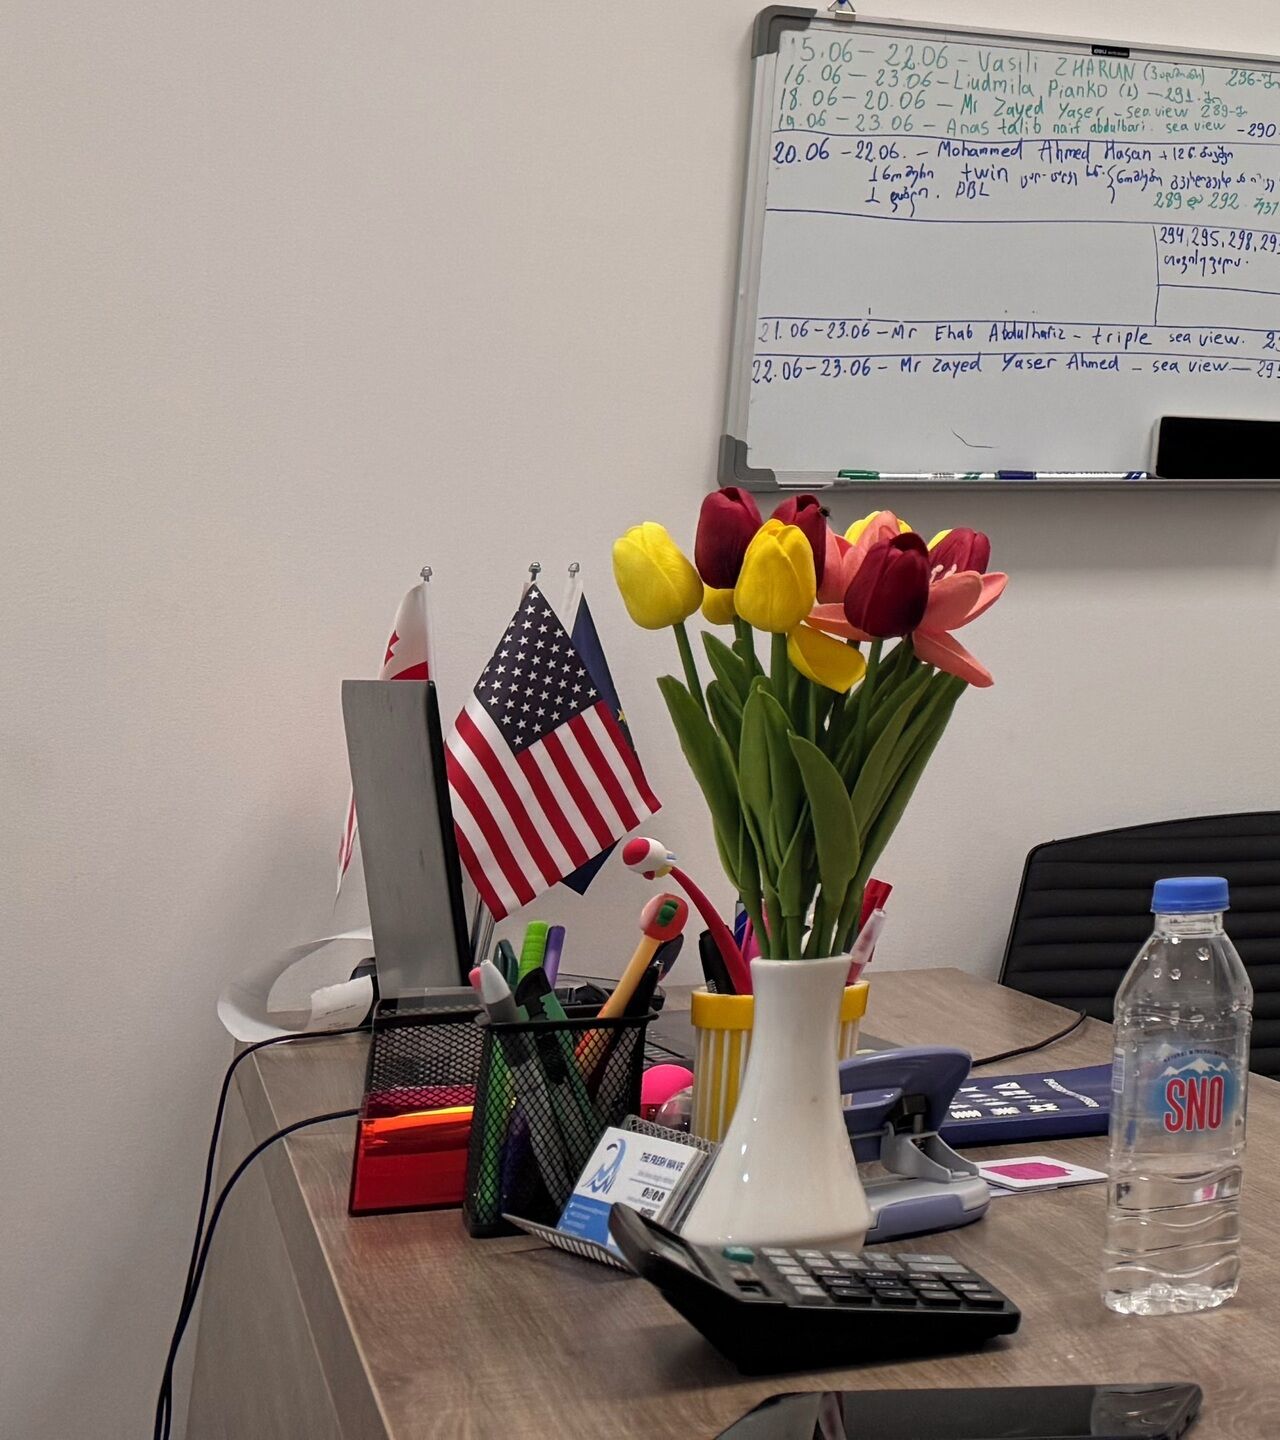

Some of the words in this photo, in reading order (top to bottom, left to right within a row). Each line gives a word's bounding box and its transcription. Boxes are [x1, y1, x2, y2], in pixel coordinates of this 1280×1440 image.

[979, 49, 1038, 74] Vasili
[954, 70, 1033, 97] Liudmila
[961, 94, 977, 115] Mr
[993, 96, 1043, 124] Zayed
[1058, 103, 1104, 124] Yaser
[1156, 106, 1188, 119] view
[947, 120, 989, 135] Anas
[998, 117, 1042, 135] talib
[1166, 122, 1188, 134] sea
[1194, 122, 1226, 134] view
[937, 138, 1023, 159] Mohammed
[1037, 140, 1091, 164] Ahmed
[1103, 140, 1151, 163] Hasan
[961, 162, 1008, 183] twin
[956, 182, 990, 200] DBL
[1154, 192, 1182, 210] 289
[1208, 192, 1239, 210] 292
[892, 321, 917, 340] Mr
[935, 324, 973, 341] Ehab
[1092, 326, 1153, 351] triple
[1169, 332, 1191, 344] sea
[900, 355, 921, 373] Mr
[1001, 353, 1057, 372] Yaser
[1066, 353, 1120, 372] Ahmed
[1153, 360, 1180, 374] sea
[1188, 360, 1230, 373] view
[1163, 1074, 1224, 1133] SNO
[640, 1152, 651, 1163] THE
[650, 1154, 666, 1168] FRESH
[665, 1159, 686, 1172] WAVE
